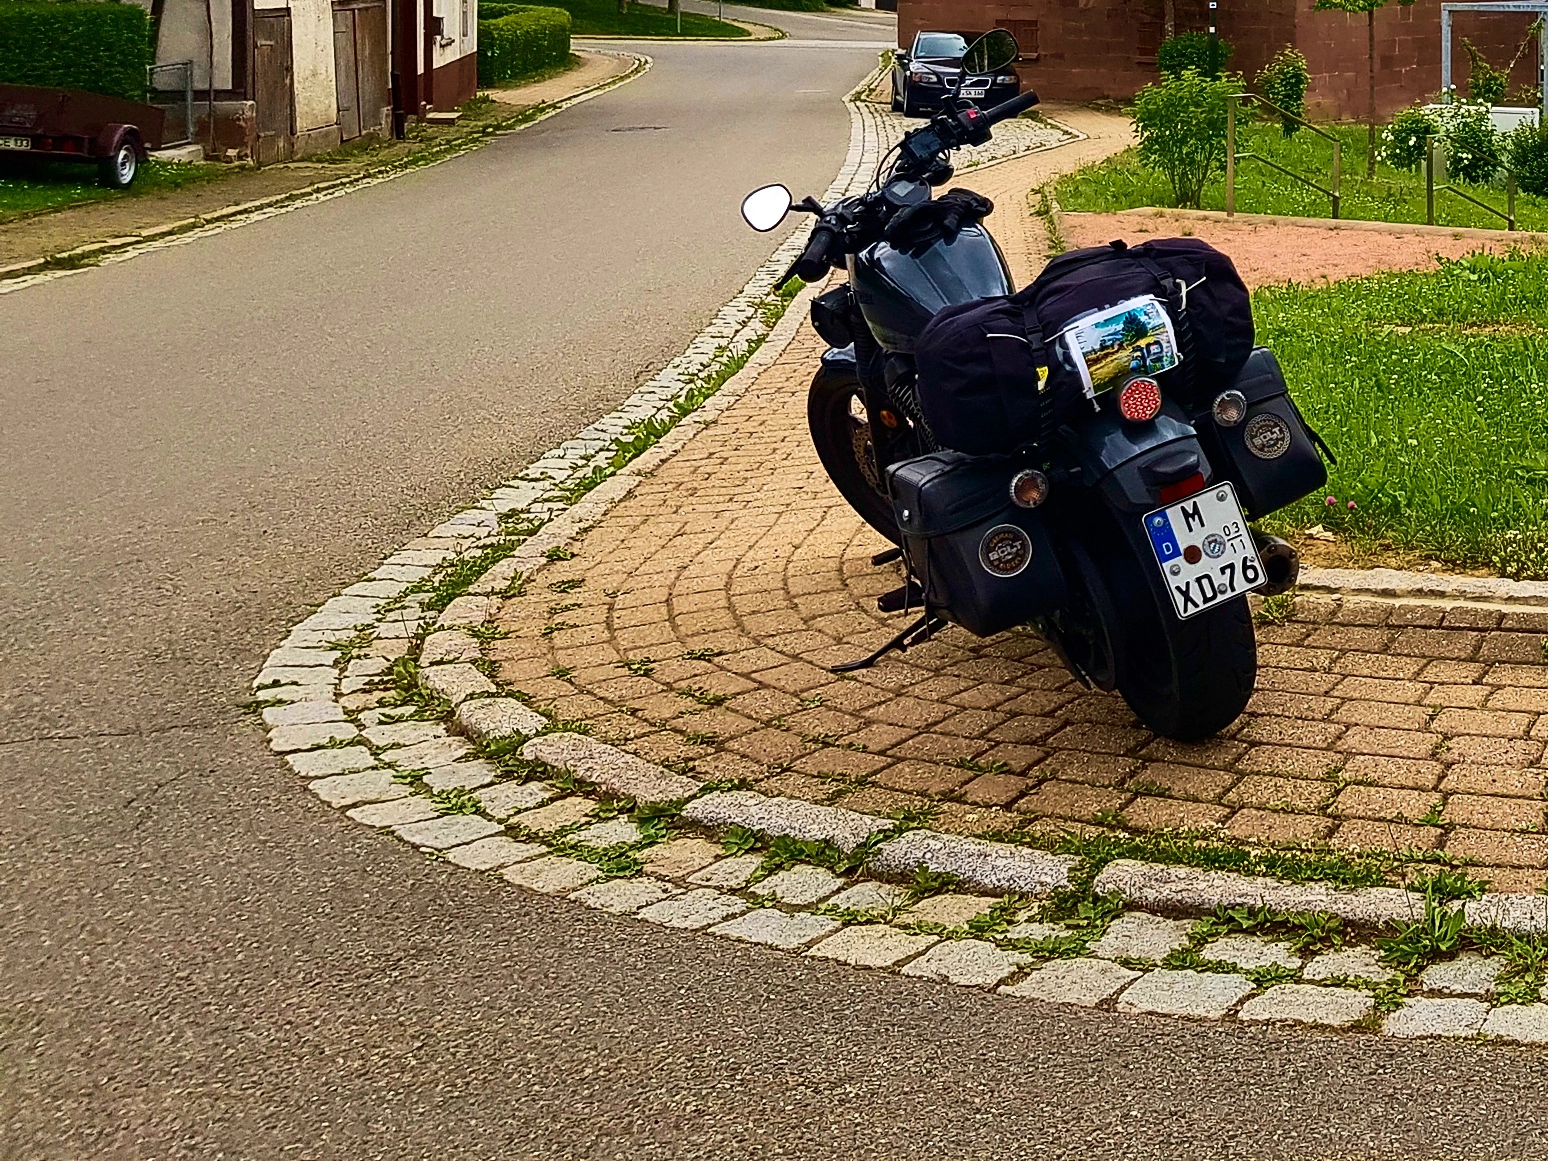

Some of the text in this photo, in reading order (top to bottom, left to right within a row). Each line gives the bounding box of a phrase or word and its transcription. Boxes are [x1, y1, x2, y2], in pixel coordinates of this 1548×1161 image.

[1180, 500, 1206, 533] M
[1222, 521, 1240, 537] 03
[988, 540, 1023, 561] BOLT
[1162, 542, 1173, 555] D
[1230, 539, 1246, 554] 11
[1219, 555, 1260, 593] 76
